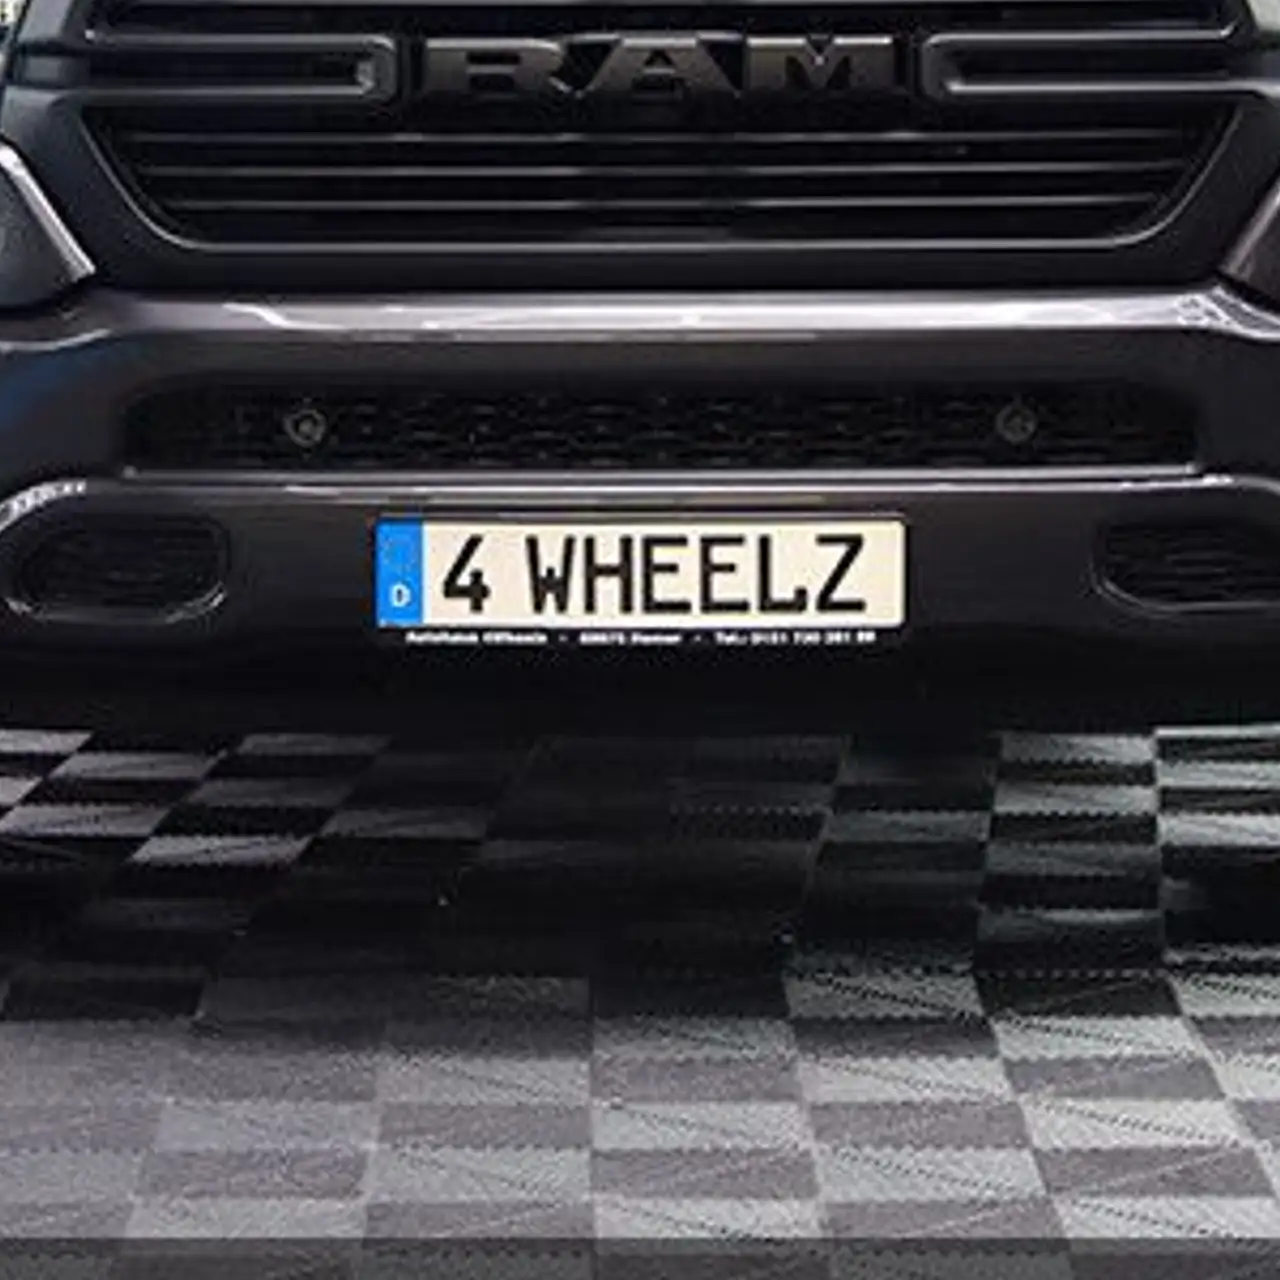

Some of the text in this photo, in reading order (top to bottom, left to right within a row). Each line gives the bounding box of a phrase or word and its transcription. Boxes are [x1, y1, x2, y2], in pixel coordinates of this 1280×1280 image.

[424, 31, 894, 100] RAM
[389, 582, 411, 608] D
[442, 534, 866, 615] 4 WHEELZ
